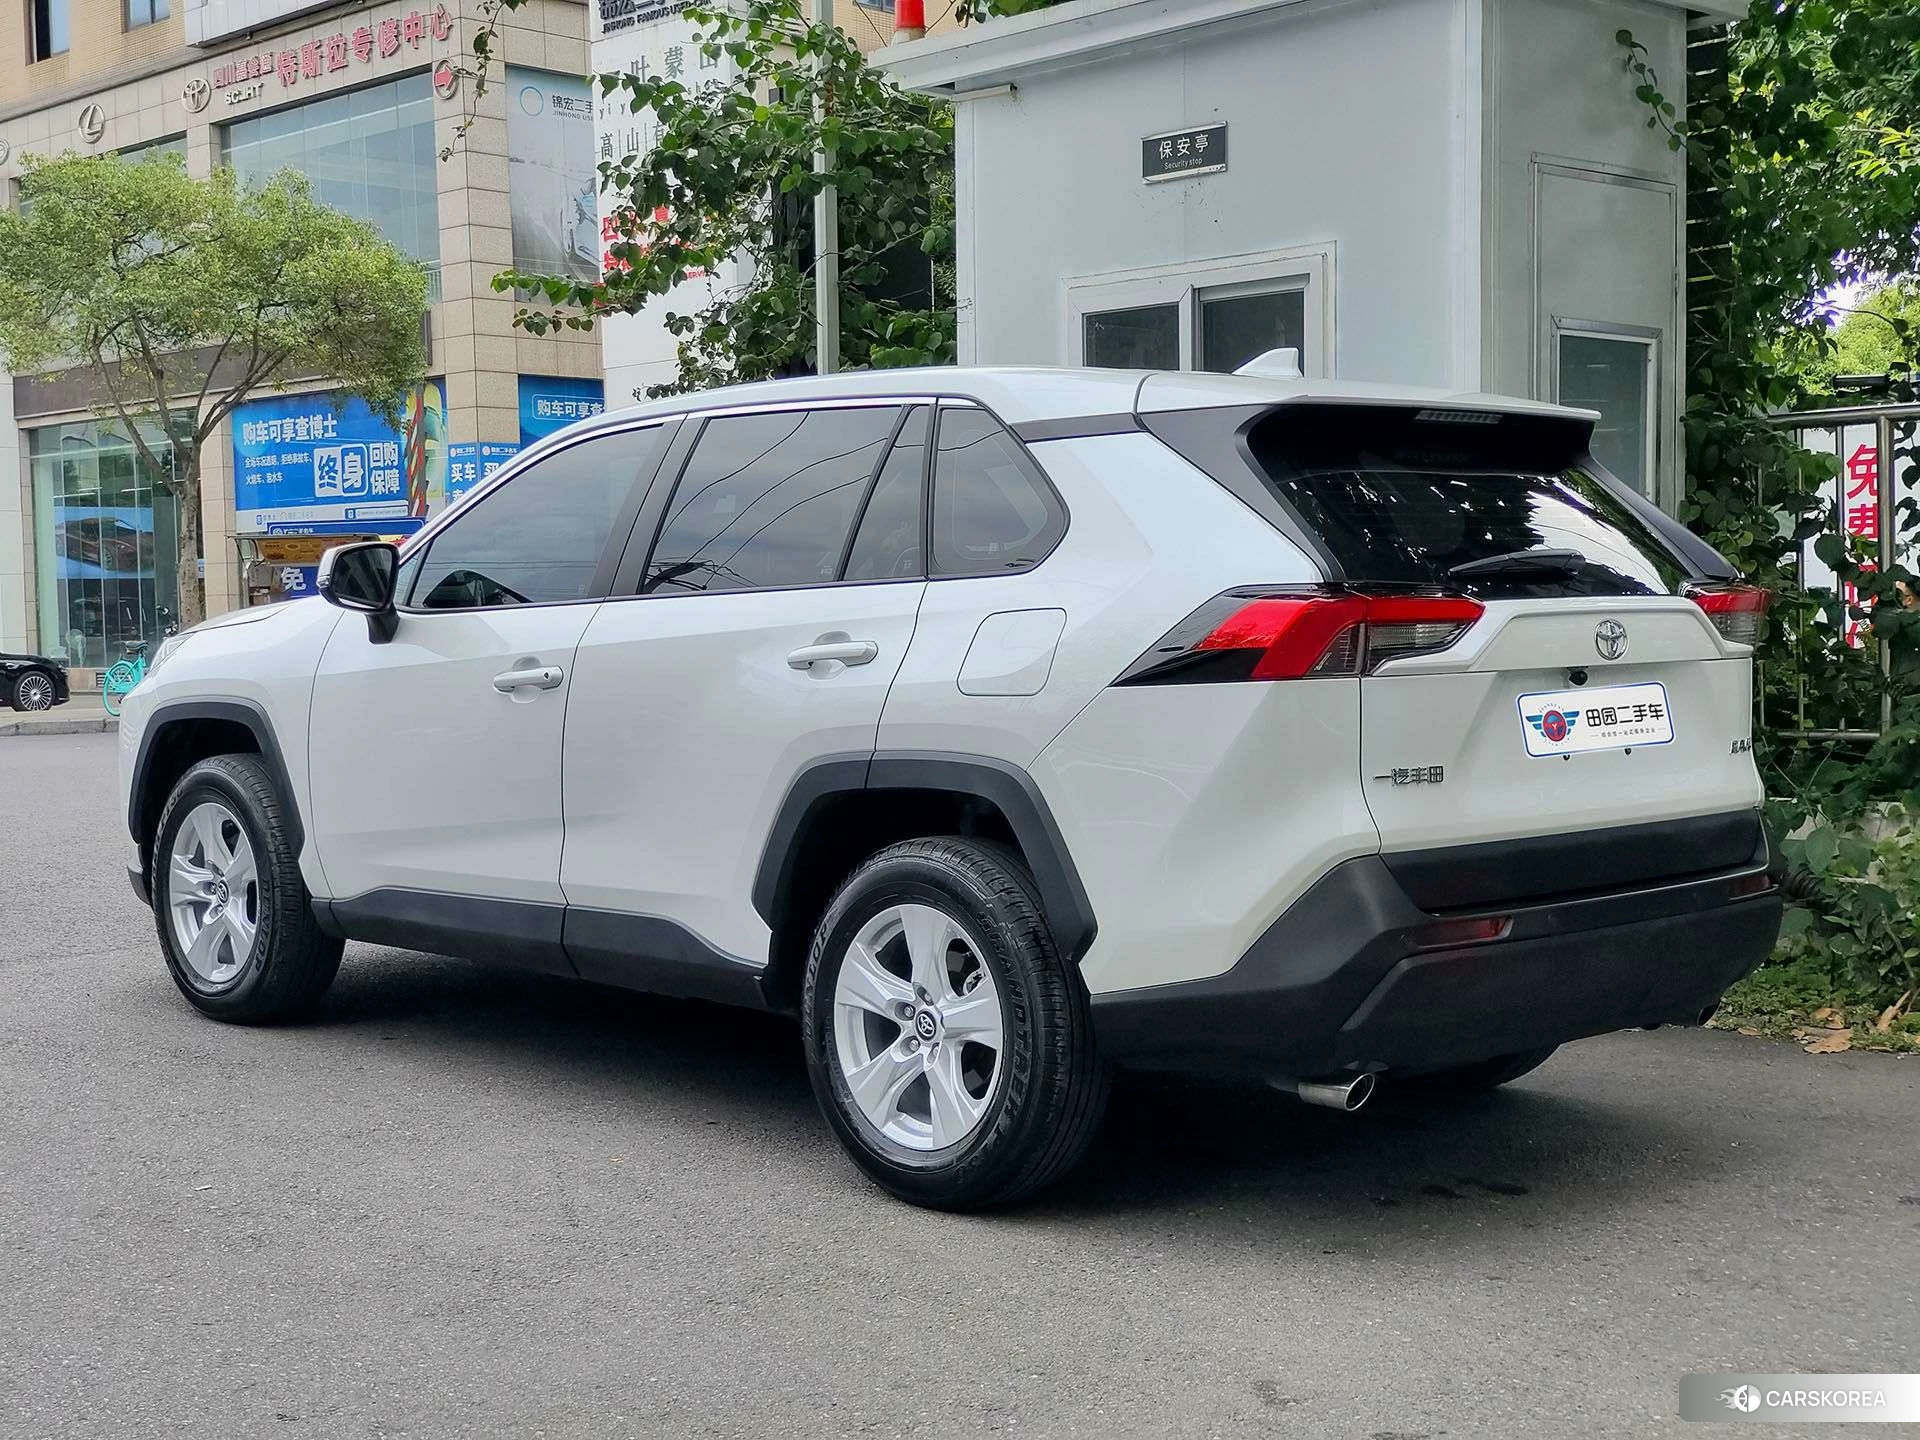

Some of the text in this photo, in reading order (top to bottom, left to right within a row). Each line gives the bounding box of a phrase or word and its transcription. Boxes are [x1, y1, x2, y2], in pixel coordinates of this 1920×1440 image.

[275, 2, 452, 87] 特斯拉专修中心
[1160, 133, 1209, 160] 保安亭
[1164, 158, 1203, 170] Security stop
[242, 413, 337, 446] 购车可享查博士
[369, 442, 399, 468] 回购
[370, 468, 400, 495] 保障
[451, 462, 477, 483] 买车
[281, 567, 307, 591] 免
[1585, 703, 1664, 727] 田园二手车
